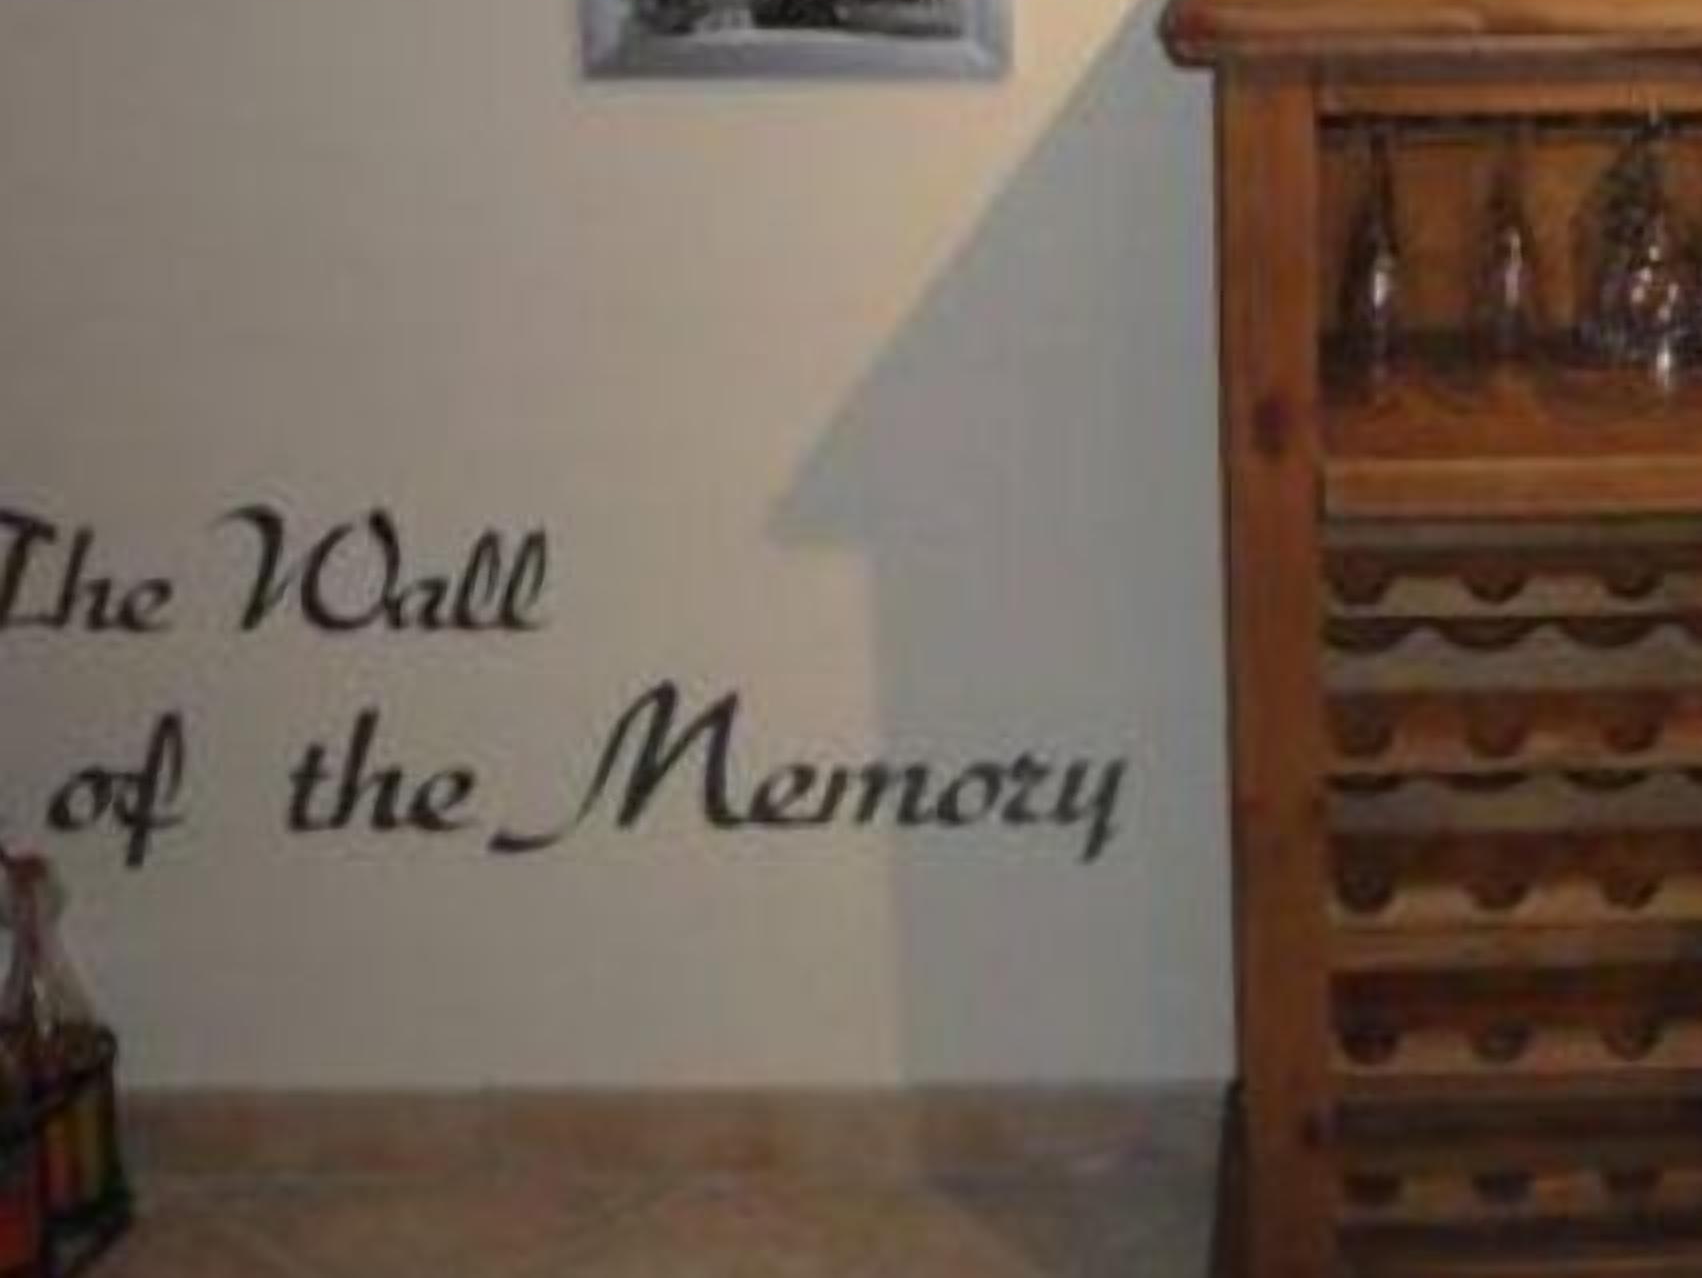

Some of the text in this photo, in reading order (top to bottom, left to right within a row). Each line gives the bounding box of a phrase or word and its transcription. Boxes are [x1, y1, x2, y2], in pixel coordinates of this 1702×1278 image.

[222, 503, 547, 634] Wall
[45, 680, 1130, 869] of the Memory
